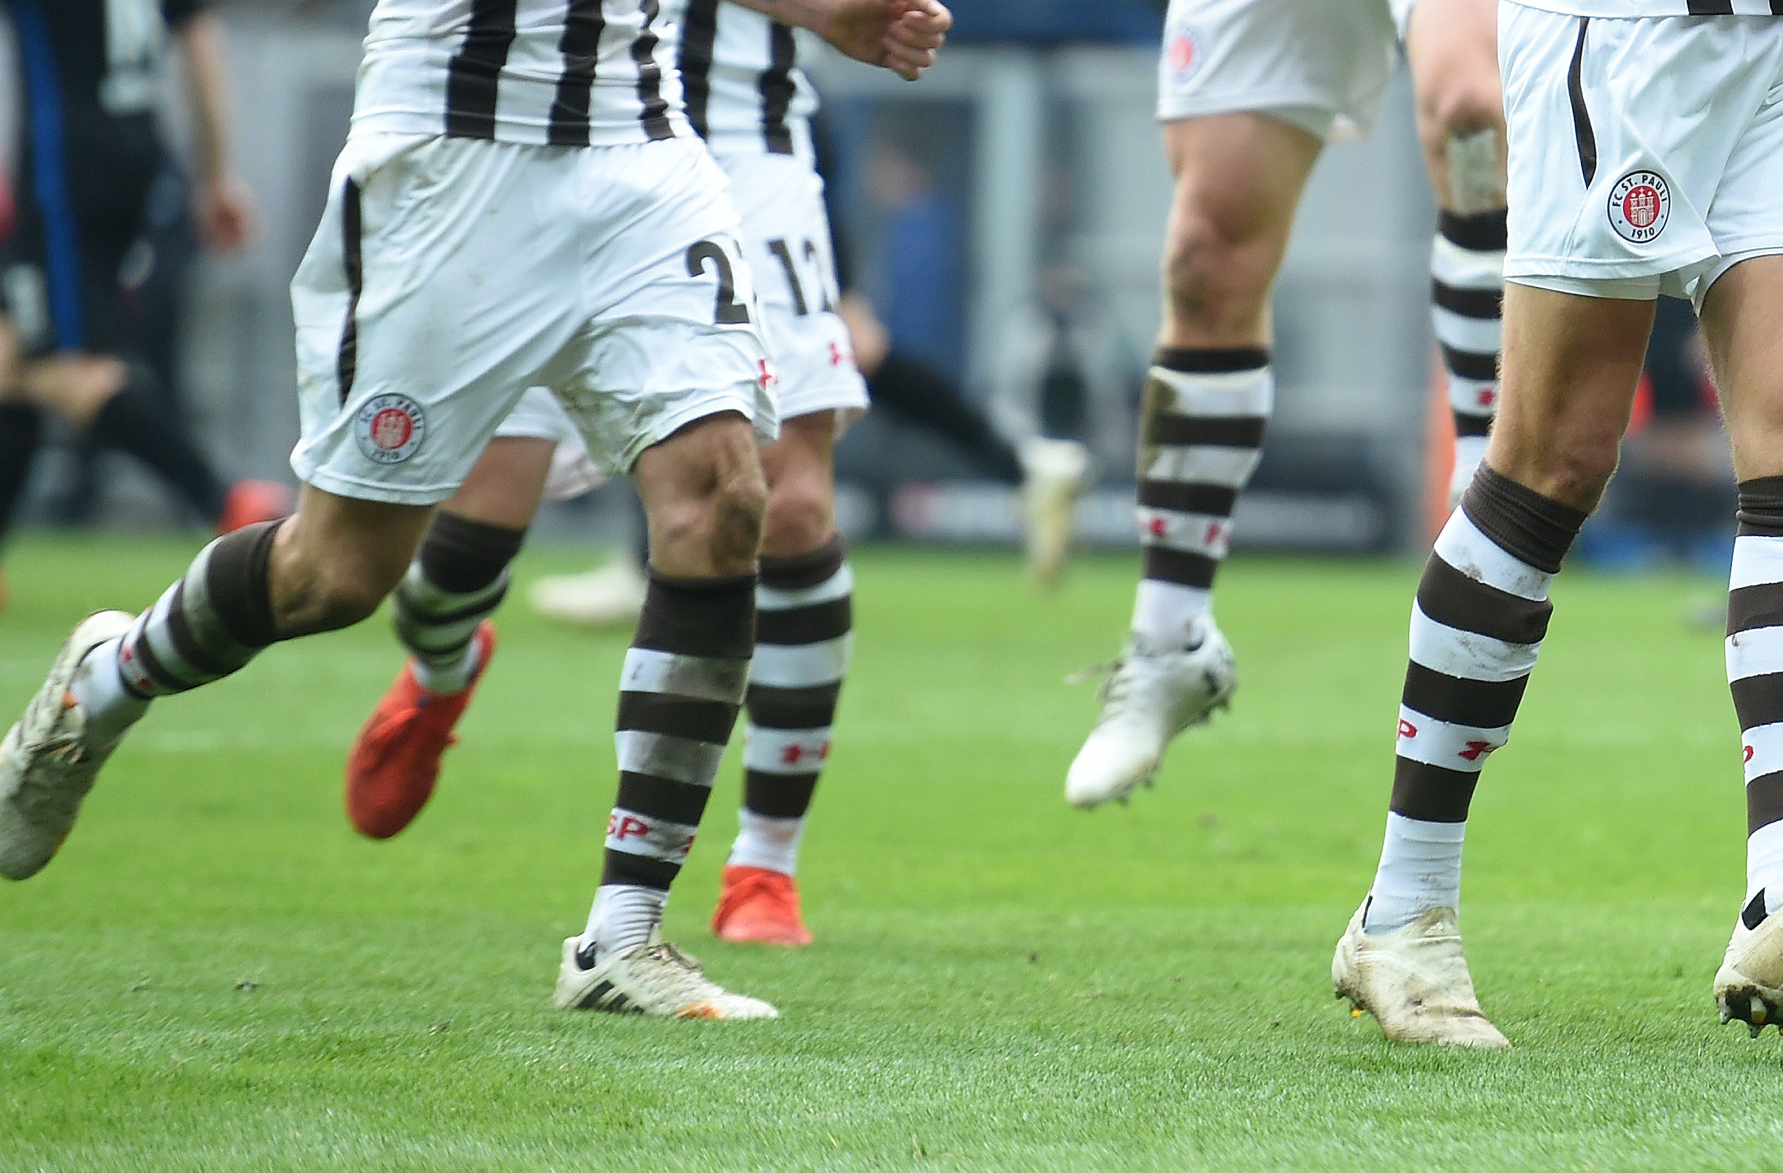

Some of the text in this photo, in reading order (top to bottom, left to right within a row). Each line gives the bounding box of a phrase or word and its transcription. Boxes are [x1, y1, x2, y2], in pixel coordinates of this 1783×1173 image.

[1612, 174, 1668, 208] FC ST. PAULI
[1631, 227, 1655, 239] 1910
[686, 240, 758, 325] 2
